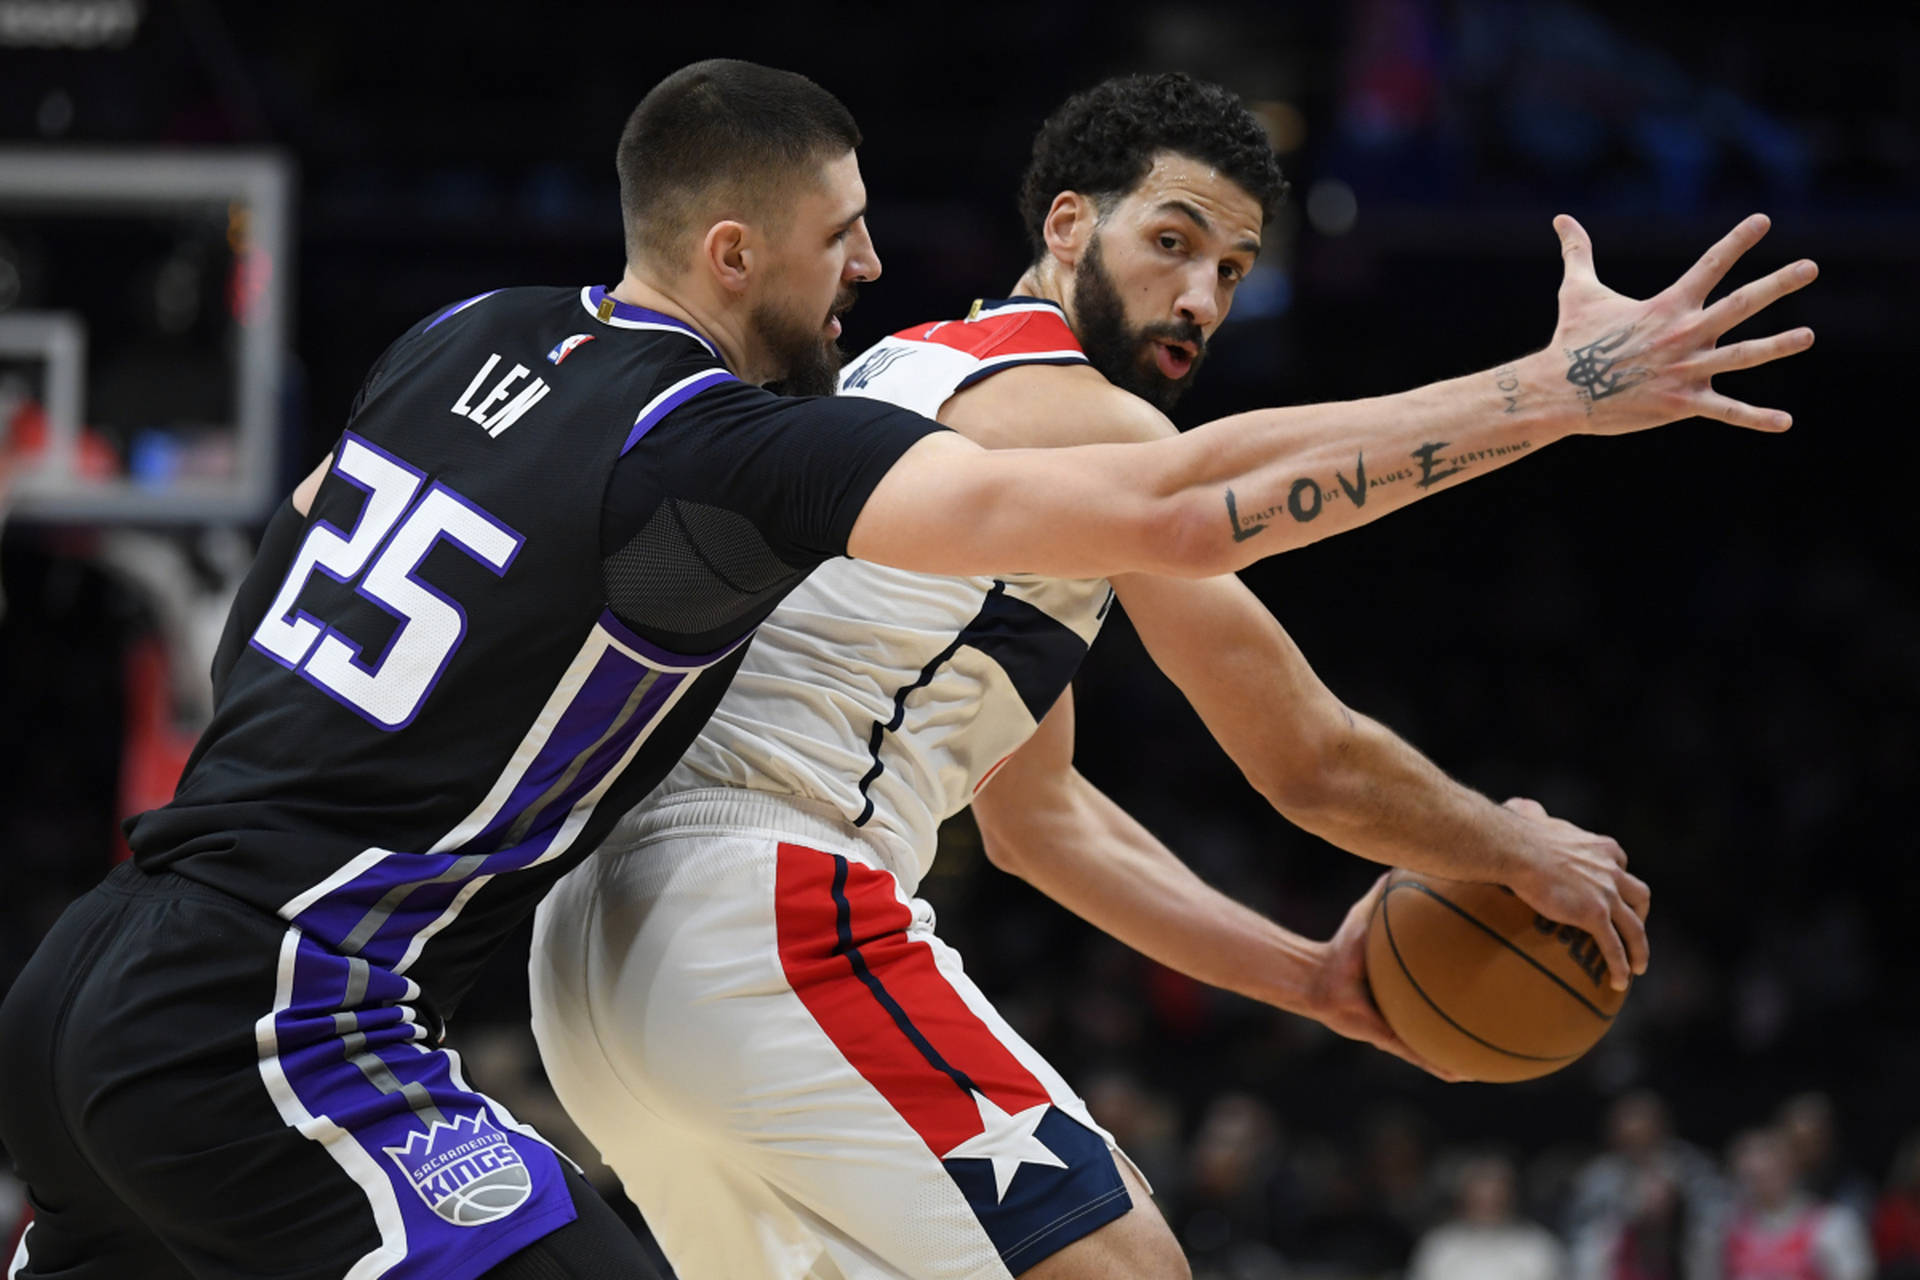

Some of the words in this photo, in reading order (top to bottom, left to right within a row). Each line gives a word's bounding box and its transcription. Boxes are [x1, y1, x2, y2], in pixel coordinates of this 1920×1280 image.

[450, 353, 551, 439] LEN
[249, 430, 527, 732] 25
[413, 1133, 502, 1180] SACRAMENTO
[420, 1146, 521, 1206] KINGS
